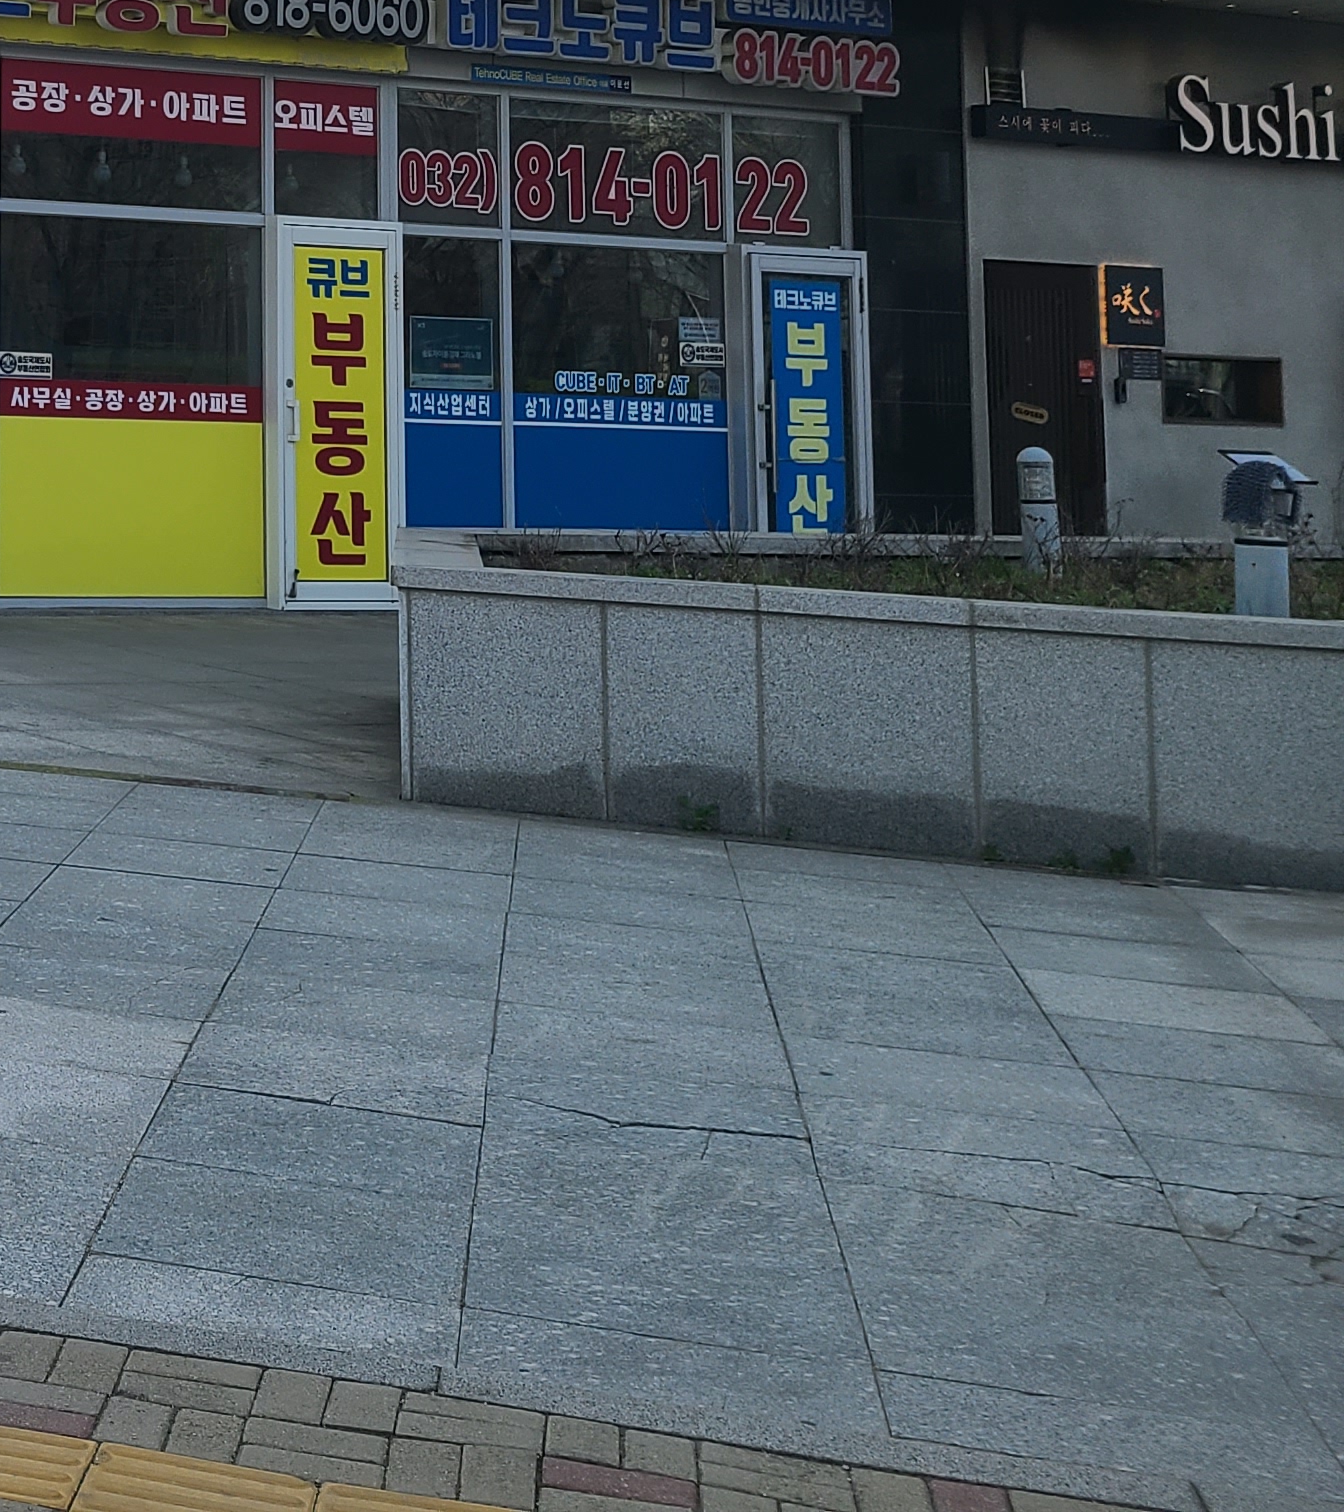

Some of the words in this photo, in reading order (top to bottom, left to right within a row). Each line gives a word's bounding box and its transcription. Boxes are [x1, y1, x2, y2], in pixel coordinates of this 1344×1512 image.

[525, 71, 543, 83] Real
[545, 73, 571, 85] Estate
[573, 75, 598, 87] Office
[734, 28, 901, 97] 814-0122
[274, 98, 376, 138] 오피스텔
[998, 115, 1033, 131] 스시에
[1039, 117, 1062, 134] 꽃이
[1177, 74, 1341, 162] Sushi
[513, 139, 810, 237] 814-0122
[306, 256, 371, 299] 큐브
[773, 288, 838, 312] 테크노큐브
[1111, 282, 1154, 316] 咲く
[408, 392, 492, 418] 지식산업센터
[309, 311, 373, 567] 부동산
[784, 321, 834, 536] 부동산
